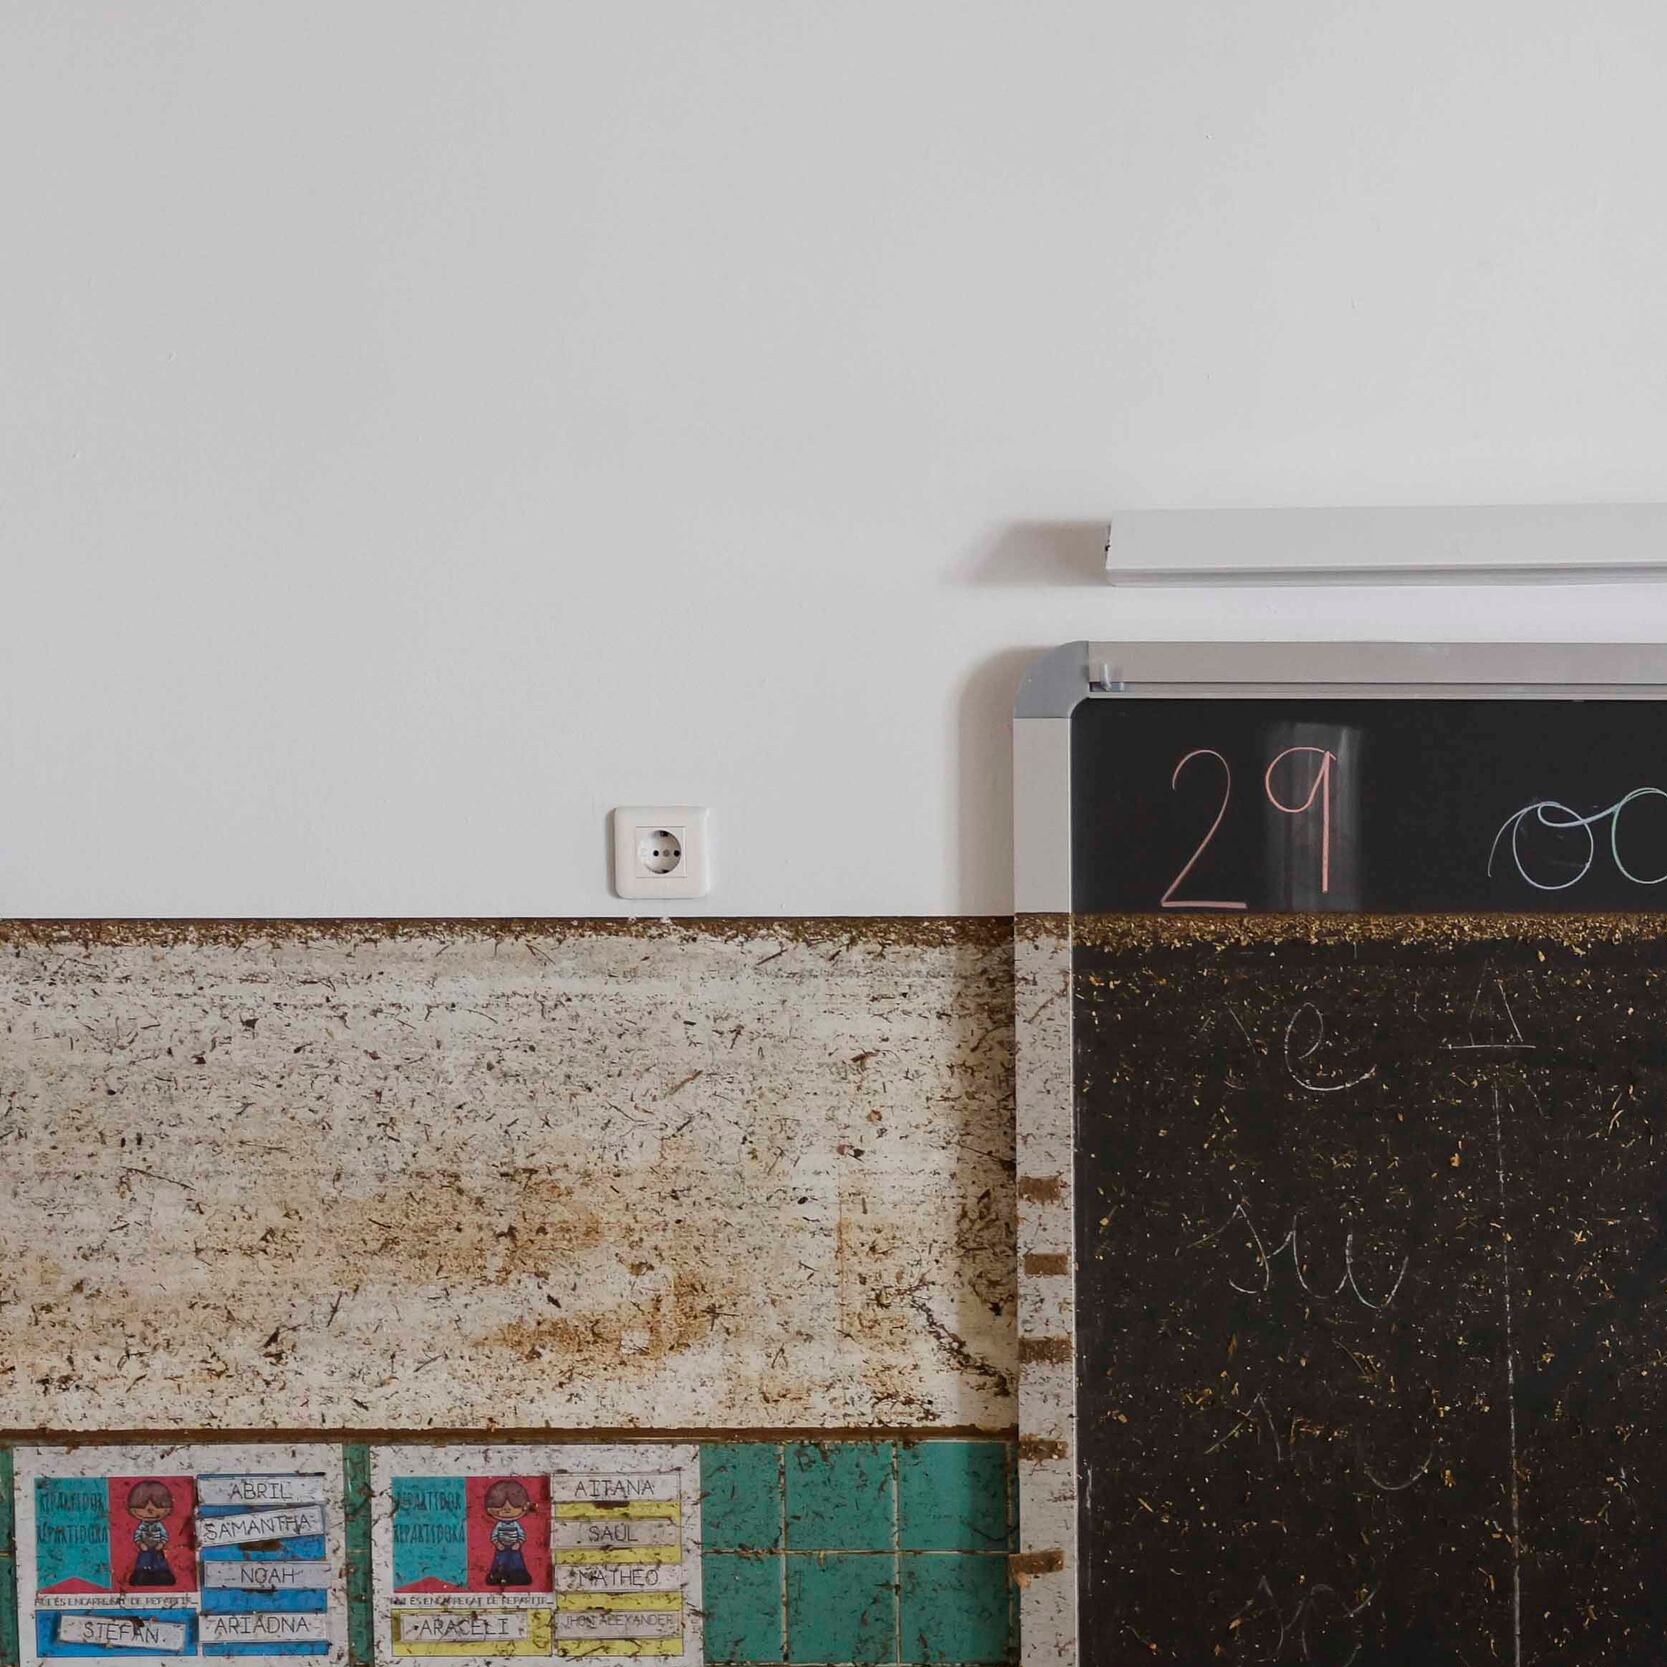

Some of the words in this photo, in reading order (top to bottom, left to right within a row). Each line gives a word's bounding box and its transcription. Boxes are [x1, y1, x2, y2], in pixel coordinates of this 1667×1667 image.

[1160, 746, 1337, 910] 29
[229, 1482, 294, 1500] ABRIL
[574, 1479, 655, 1497] AITANA
[204, 1514, 312, 1541] SAMANTHA
[240, 1567, 295, 1585] NOAH
[580, 1568, 659, 1587] MATHEO
[214, 1616, 311, 1635] ARIADNA
[420, 1618, 512, 1636] ARACELI
